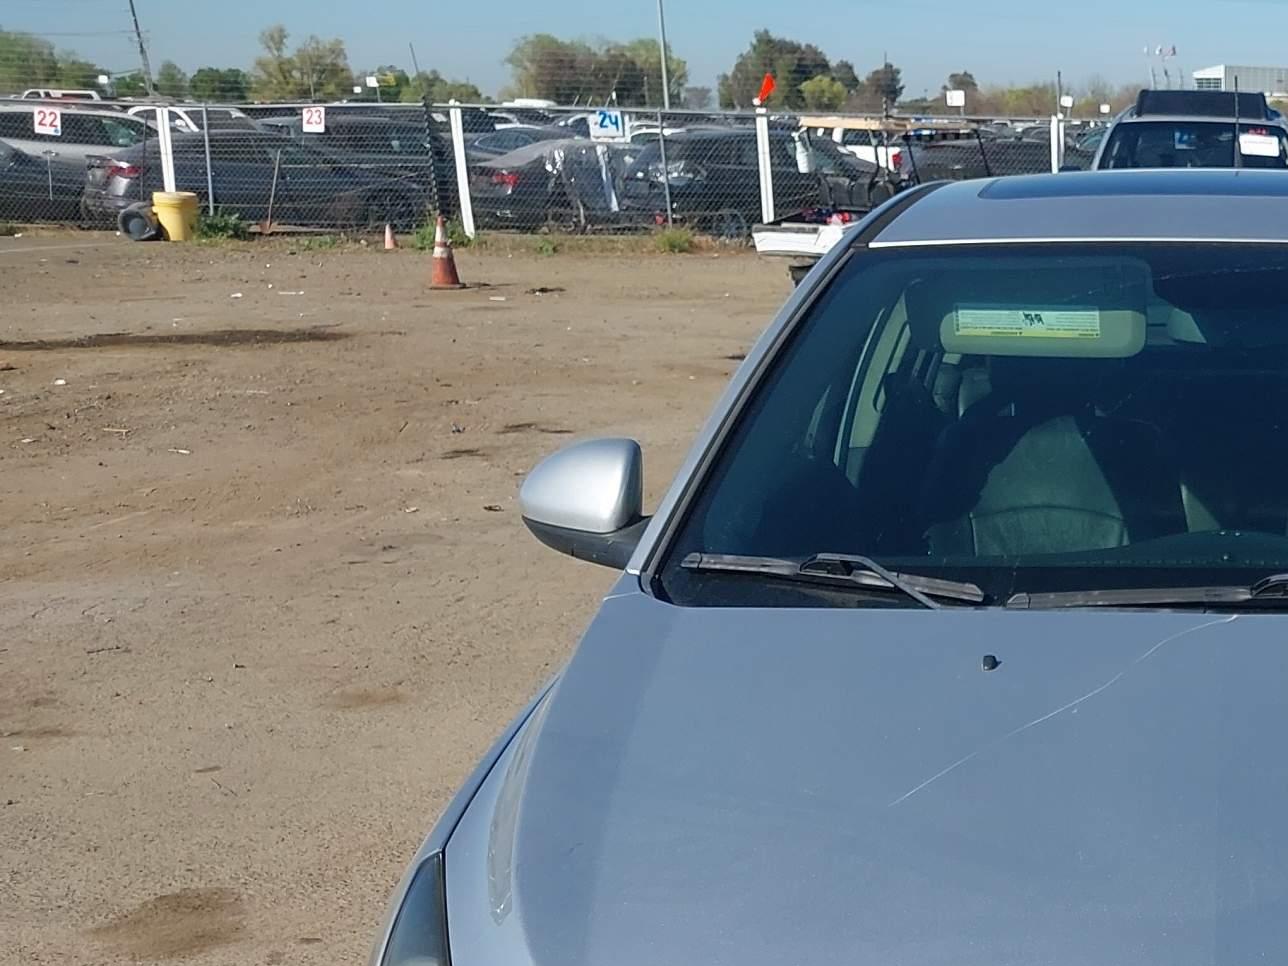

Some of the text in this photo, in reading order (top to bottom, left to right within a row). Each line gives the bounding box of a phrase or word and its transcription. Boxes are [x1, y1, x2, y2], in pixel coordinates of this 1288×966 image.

[37, 110, 59, 128] 22
[305, 109, 323, 125] 23
[598, 110, 620, 132] 24
